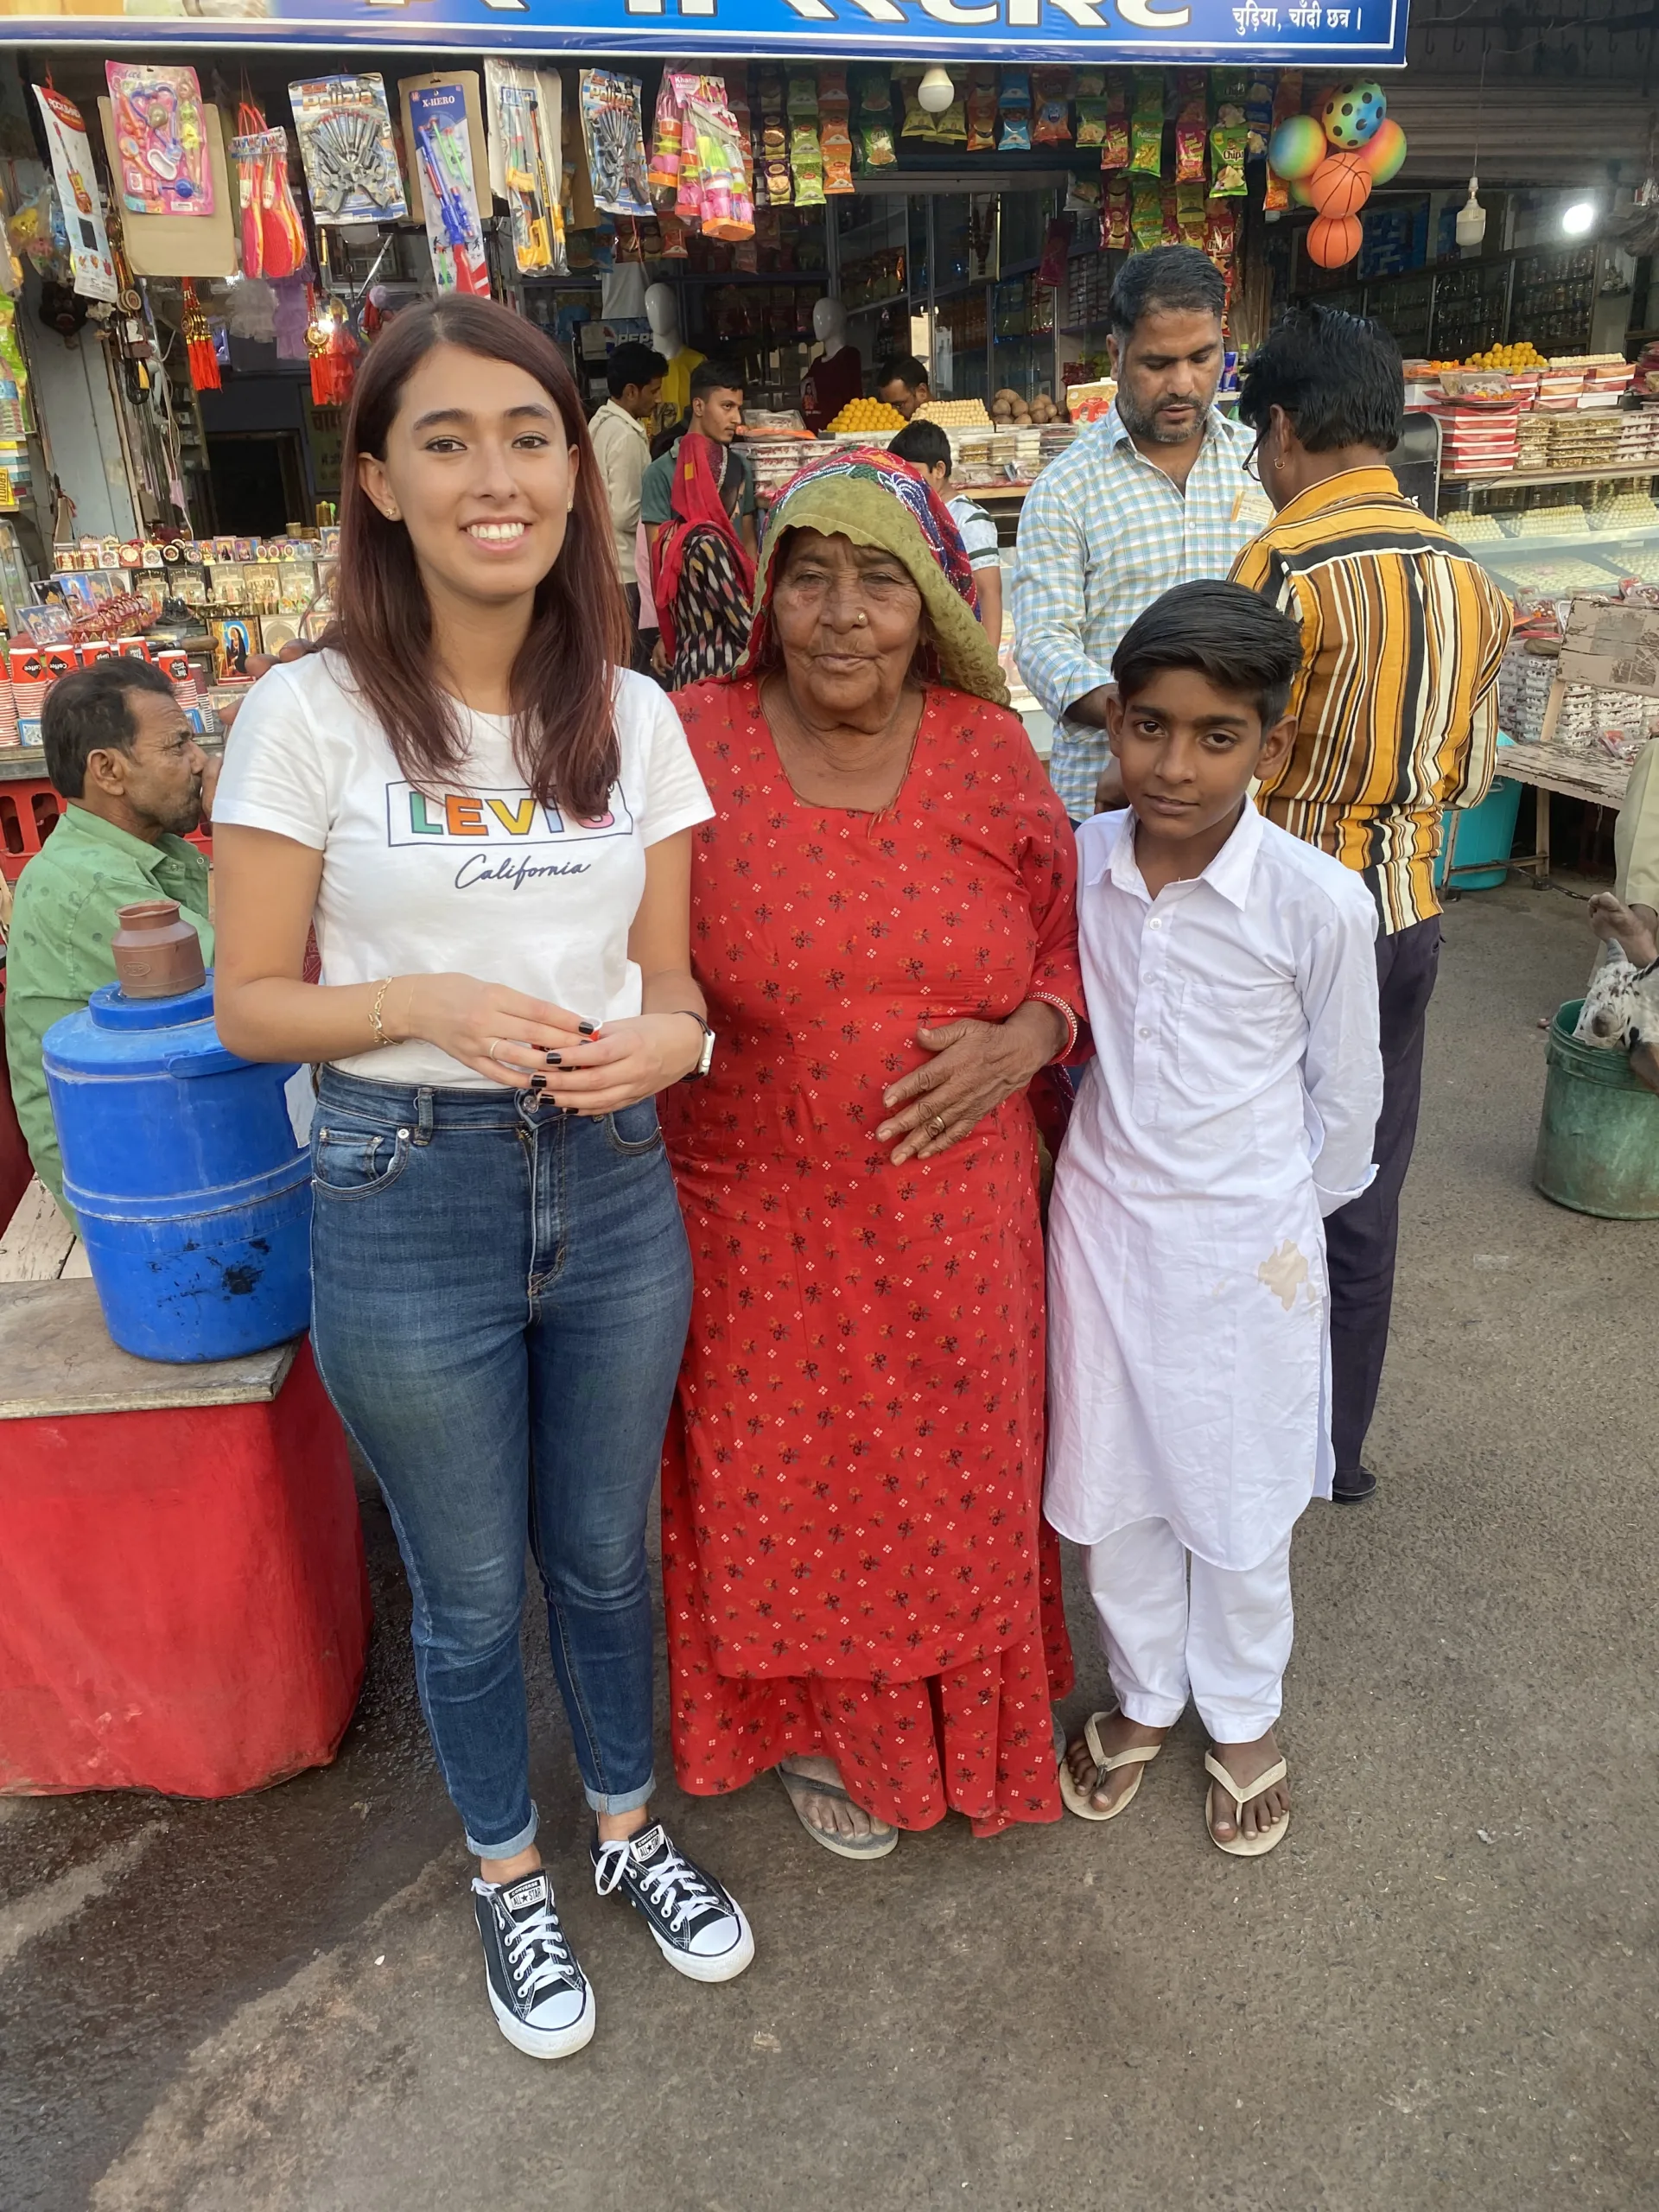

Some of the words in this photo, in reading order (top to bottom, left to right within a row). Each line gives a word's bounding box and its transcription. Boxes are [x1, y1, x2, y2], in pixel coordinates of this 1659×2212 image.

[302, 90, 372, 111] Polizia
[422, 95, 455, 108] X-HERO
[23, 664, 42, 672] Coffee
[409, 791, 615, 836] LEVI
[454, 854, 591, 891] California
[511, 1881, 538, 1897] CONVERSE
[513, 1895, 523, 1906] ALL
[528, 1887, 542, 1901] STAR
